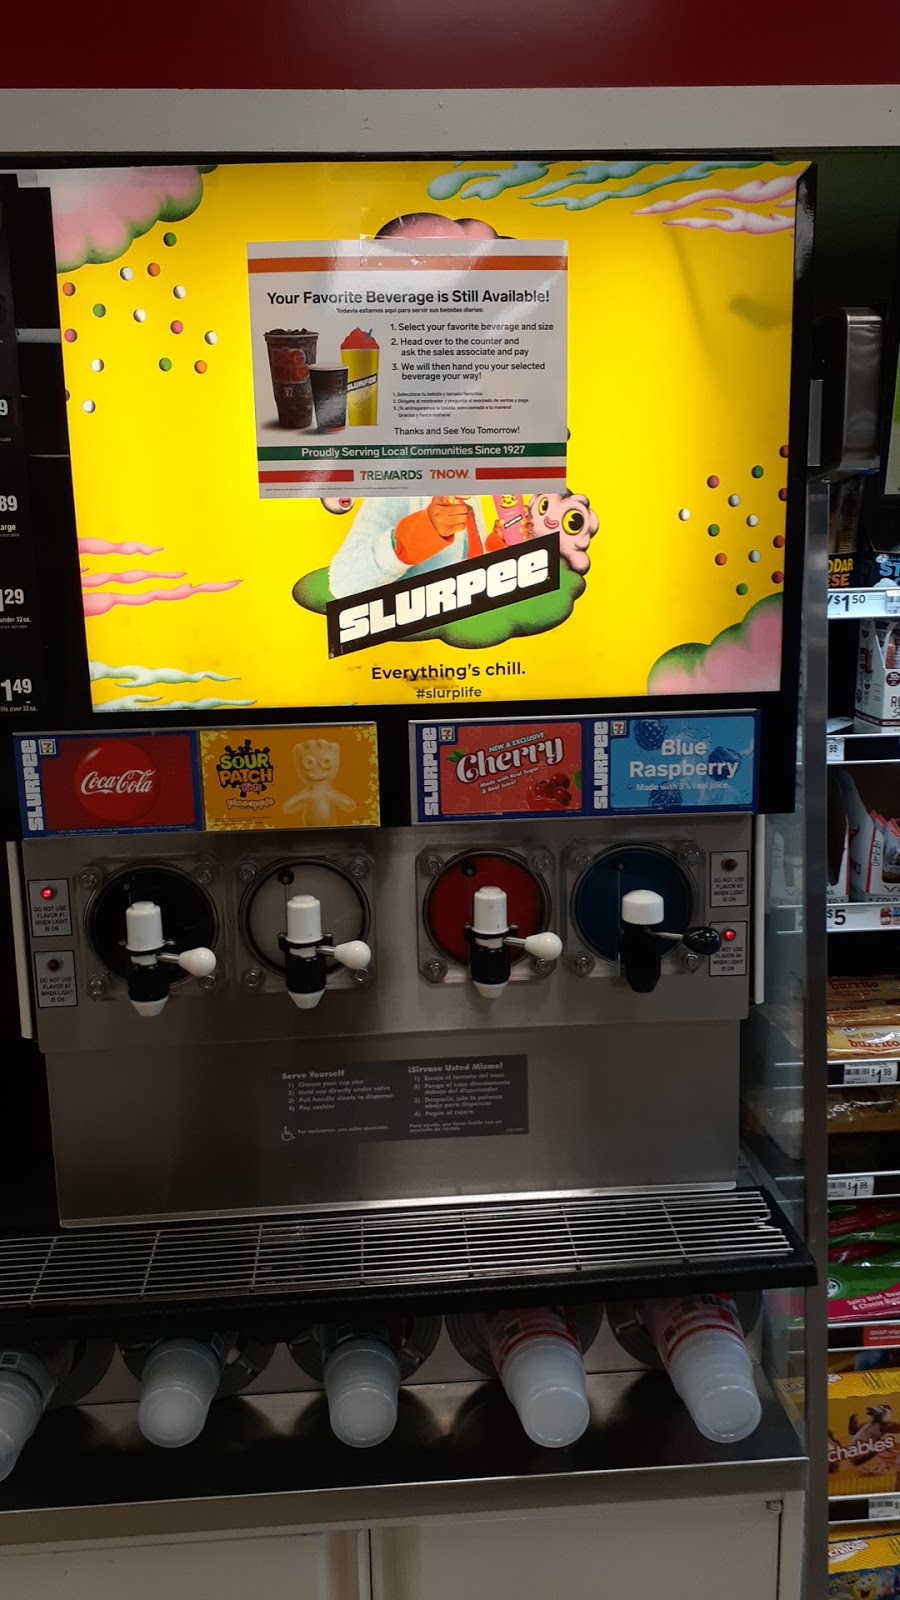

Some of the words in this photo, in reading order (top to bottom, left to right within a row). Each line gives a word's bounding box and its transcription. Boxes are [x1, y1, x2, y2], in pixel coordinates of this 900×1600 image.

[266, 292, 300, 304] Your
[303, 290, 362, 304] Favorite
[366, 290, 434, 306] Beverage
[437, 290, 448, 303] is
[452, 290, 478, 303] Still
[482, 290, 550, 303] Available!
[398, 323, 426, 331] Select
[480, 323, 520, 332] beverage
[391, 338, 398, 346] 2.
[418, 348, 431, 356] the
[432, 348, 454, 356] sales
[474, 364, 489, 372] you
[491, 364, 508, 372] your
[510, 362, 545, 370] selected
[402, 373, 440, 381] beverage
[462, 372, 482, 381] way!
[394, 427, 424, 435] Thanks
[426, 427, 441, 435] and
[477, 426, 520, 434] Tomorrow!
[302, 447, 339, 458] Proudly
[342, 448, 380, 458] Serving
[382, 447, 408, 456] Local
[410, 446, 473, 455] Communities
[475, 446, 501, 455] Since
[503, 445, 525, 454] 1927
[371, 664, 480, 682] Everything's
[485, 662, 526, 676] chill.
[416, 686, 482, 700] #slurplife
[489, 744, 504, 753] NEW
[512, 732, 545, 746] EXCLUSIVE
[661, 738, 707, 756] Blue
[220, 752, 270, 770] SOUR
[456, 737, 564, 783] Cherry
[629, 760, 739, 780] Raspberry
[80, 769, 156, 795] Coca-Cola
[219, 768, 273, 786] PATCH
[636, 783, 659, 791] Made
[227, 798, 275, 810] pineapple
[832, 981, 879, 990] burrito
[408, 1065, 442, 1073] ¡Sirvase
[472, 1062, 503, 1070] Mismo!
[282, 1072, 307, 1080] Serve
[309, 1069, 344, 1078] Yourself
